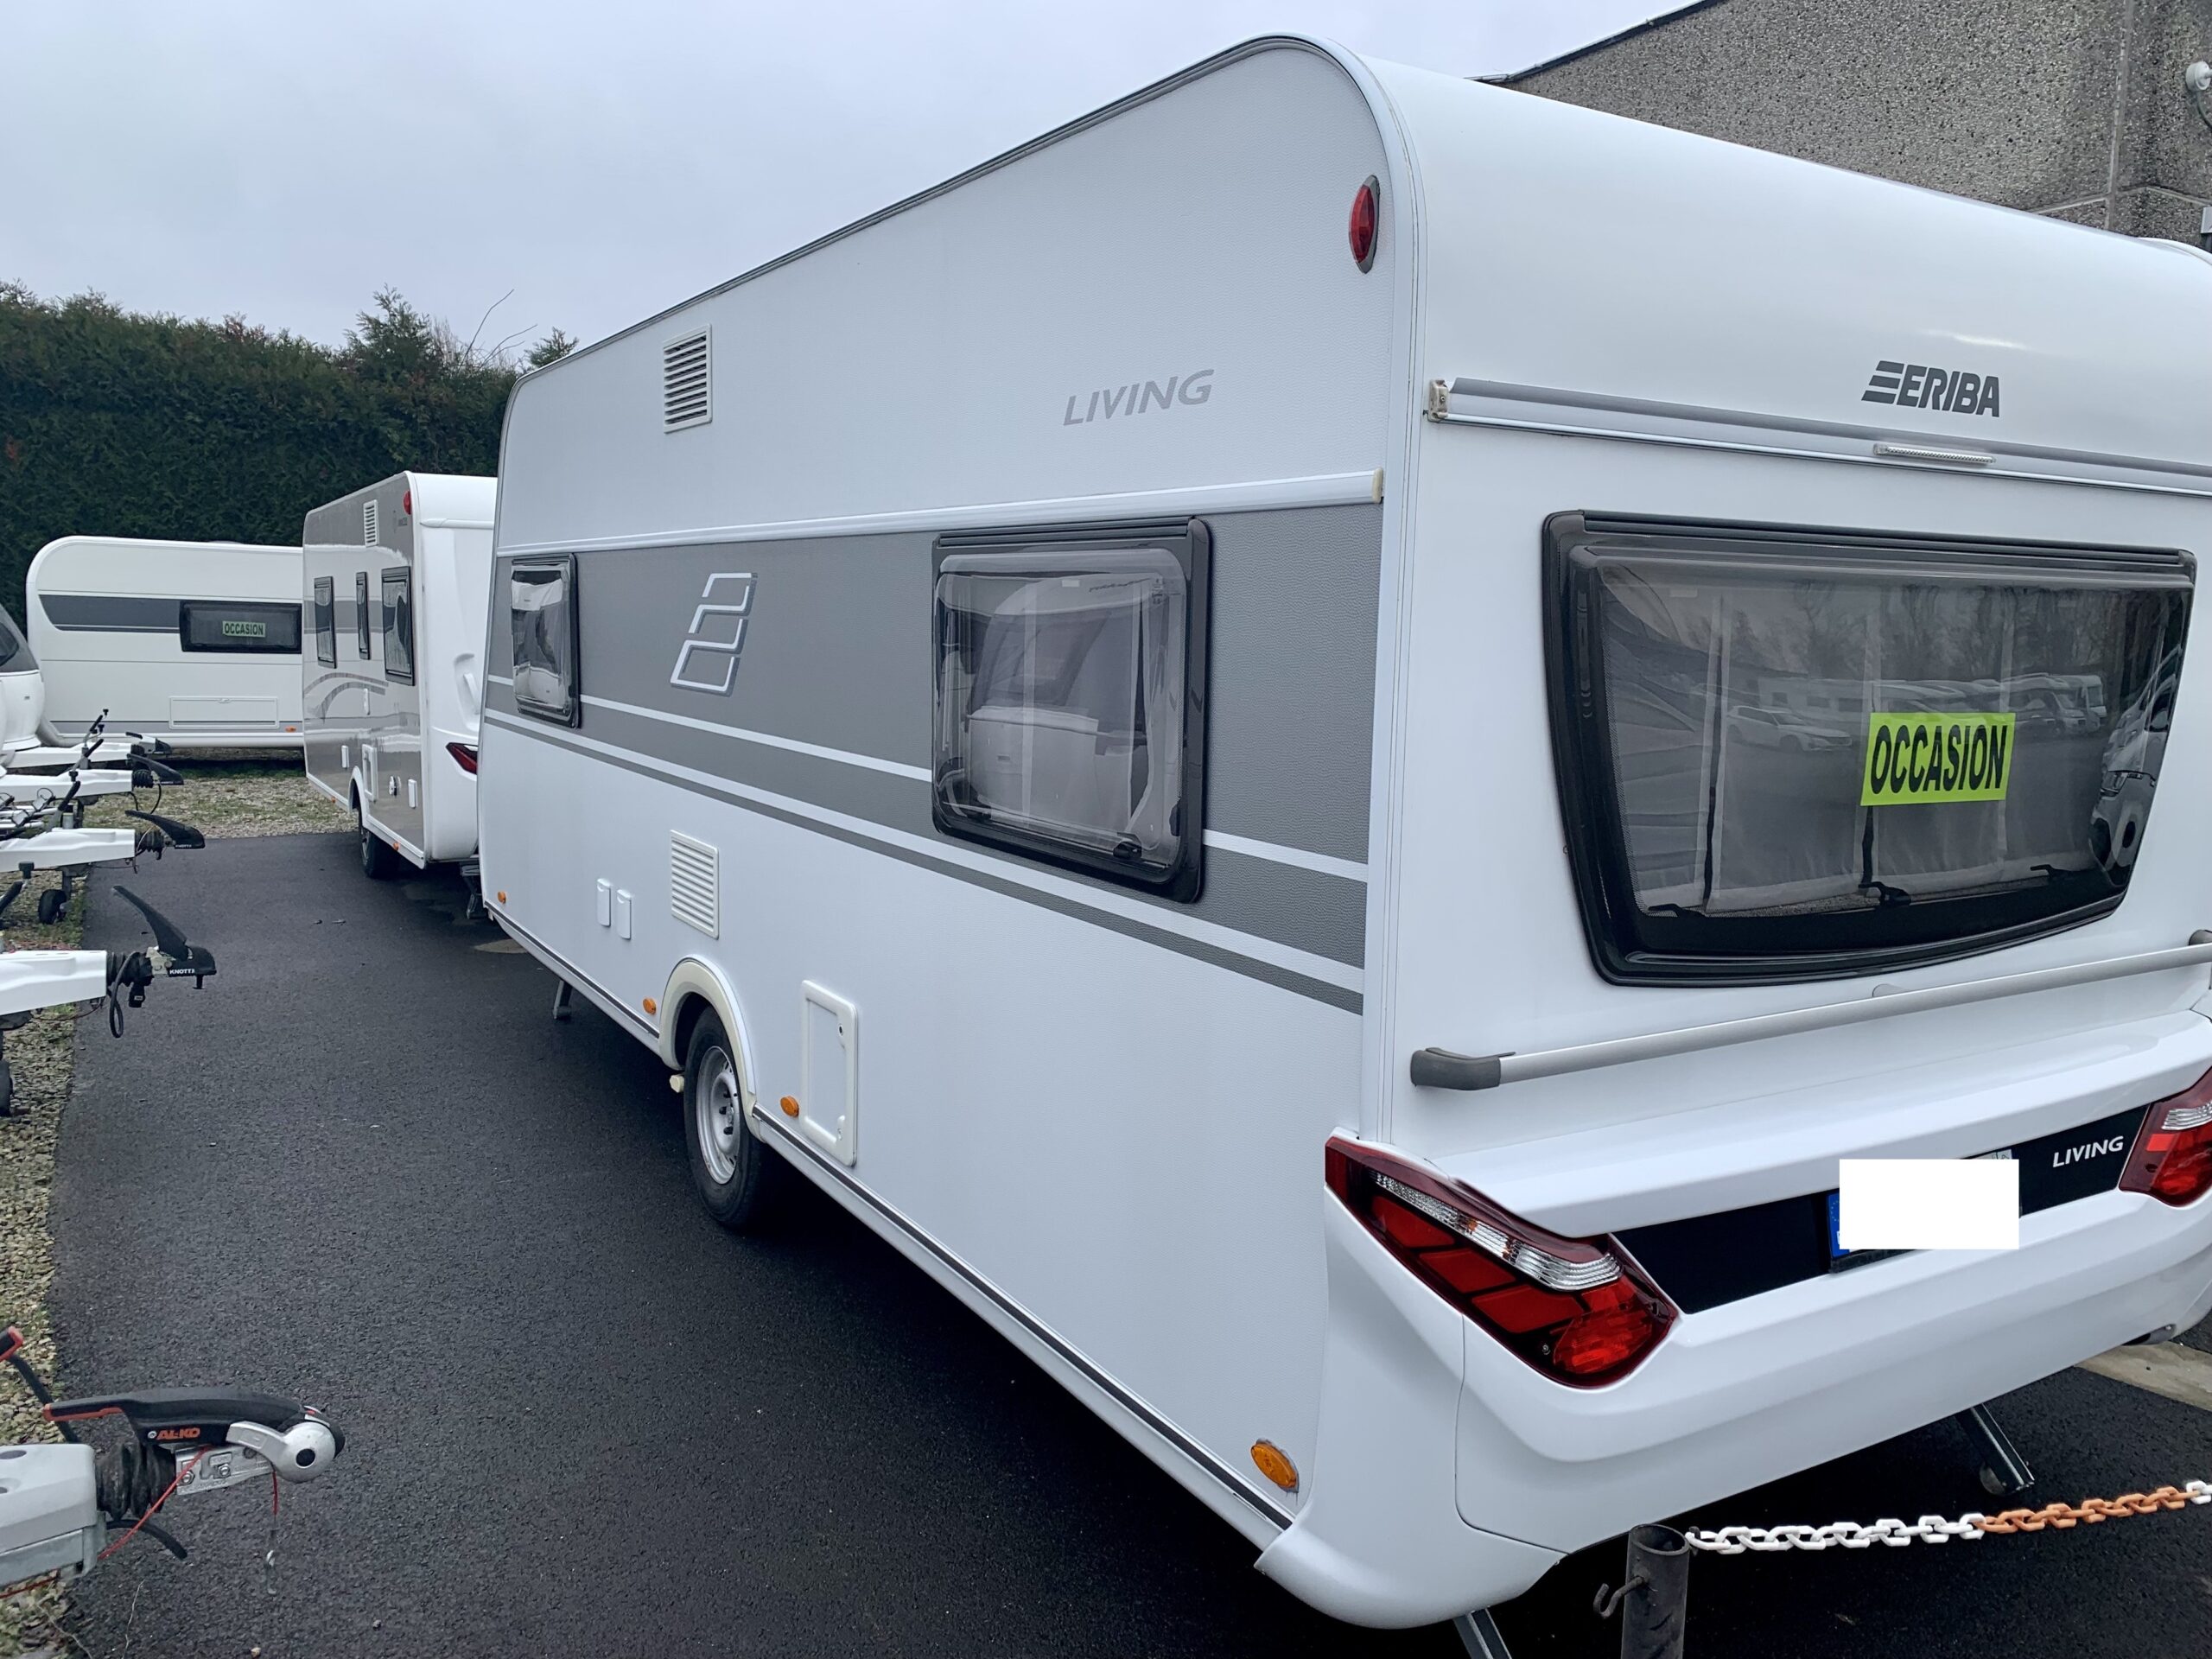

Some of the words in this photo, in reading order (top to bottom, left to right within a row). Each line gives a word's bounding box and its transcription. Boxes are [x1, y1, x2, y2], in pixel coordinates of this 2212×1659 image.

[1063, 369, 1214, 426] LIVING
[1896, 364, 2000, 418] ERIBA
[225, 623, 264, 635] OCCASION
[1871, 724, 2008, 795] OCCASION
[2052, 1135, 2124, 1168] LIVING
